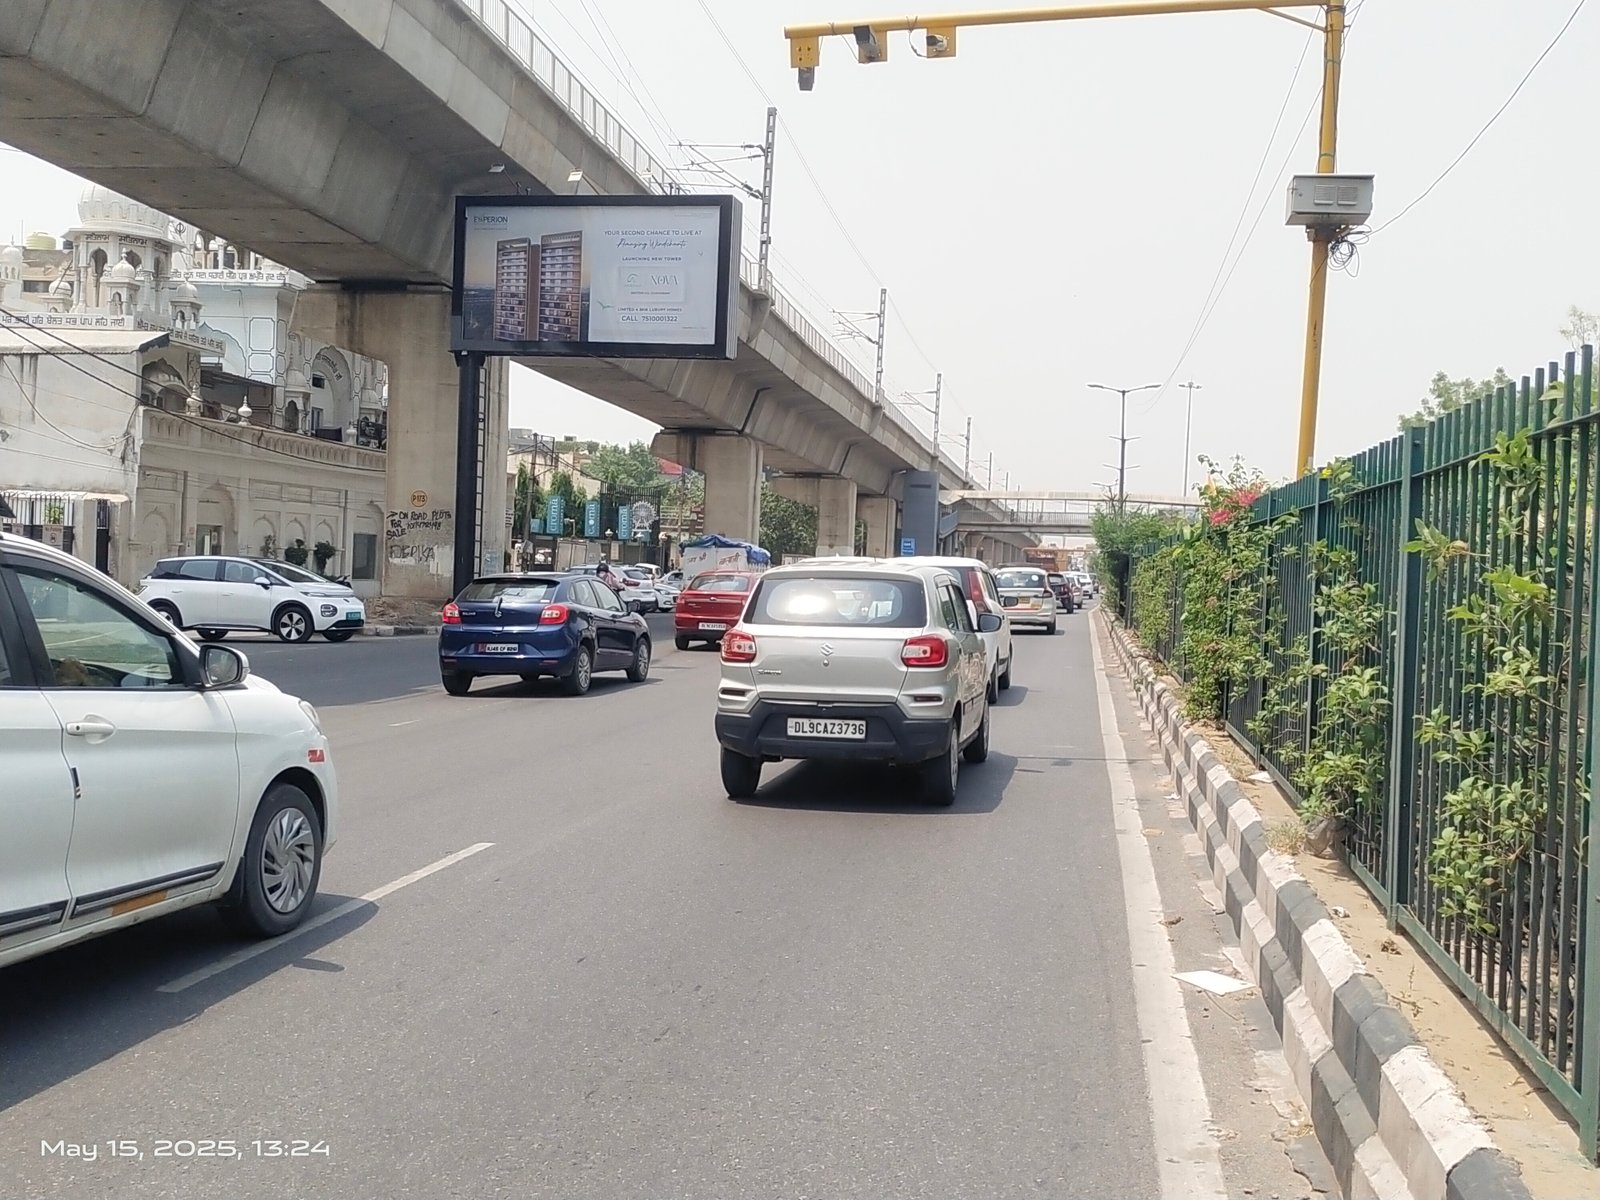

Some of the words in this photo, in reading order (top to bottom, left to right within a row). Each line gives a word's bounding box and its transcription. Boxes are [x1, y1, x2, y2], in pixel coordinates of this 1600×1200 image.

[399, 510, 409, 520] ON
[410, 510, 428, 521] ROAD
[550, 498, 558, 532] croma
[390, 519, 402, 529] FOR
[386, 528, 407, 540] SALE
[794, 721, 865, 735] DL9CAZ3736
